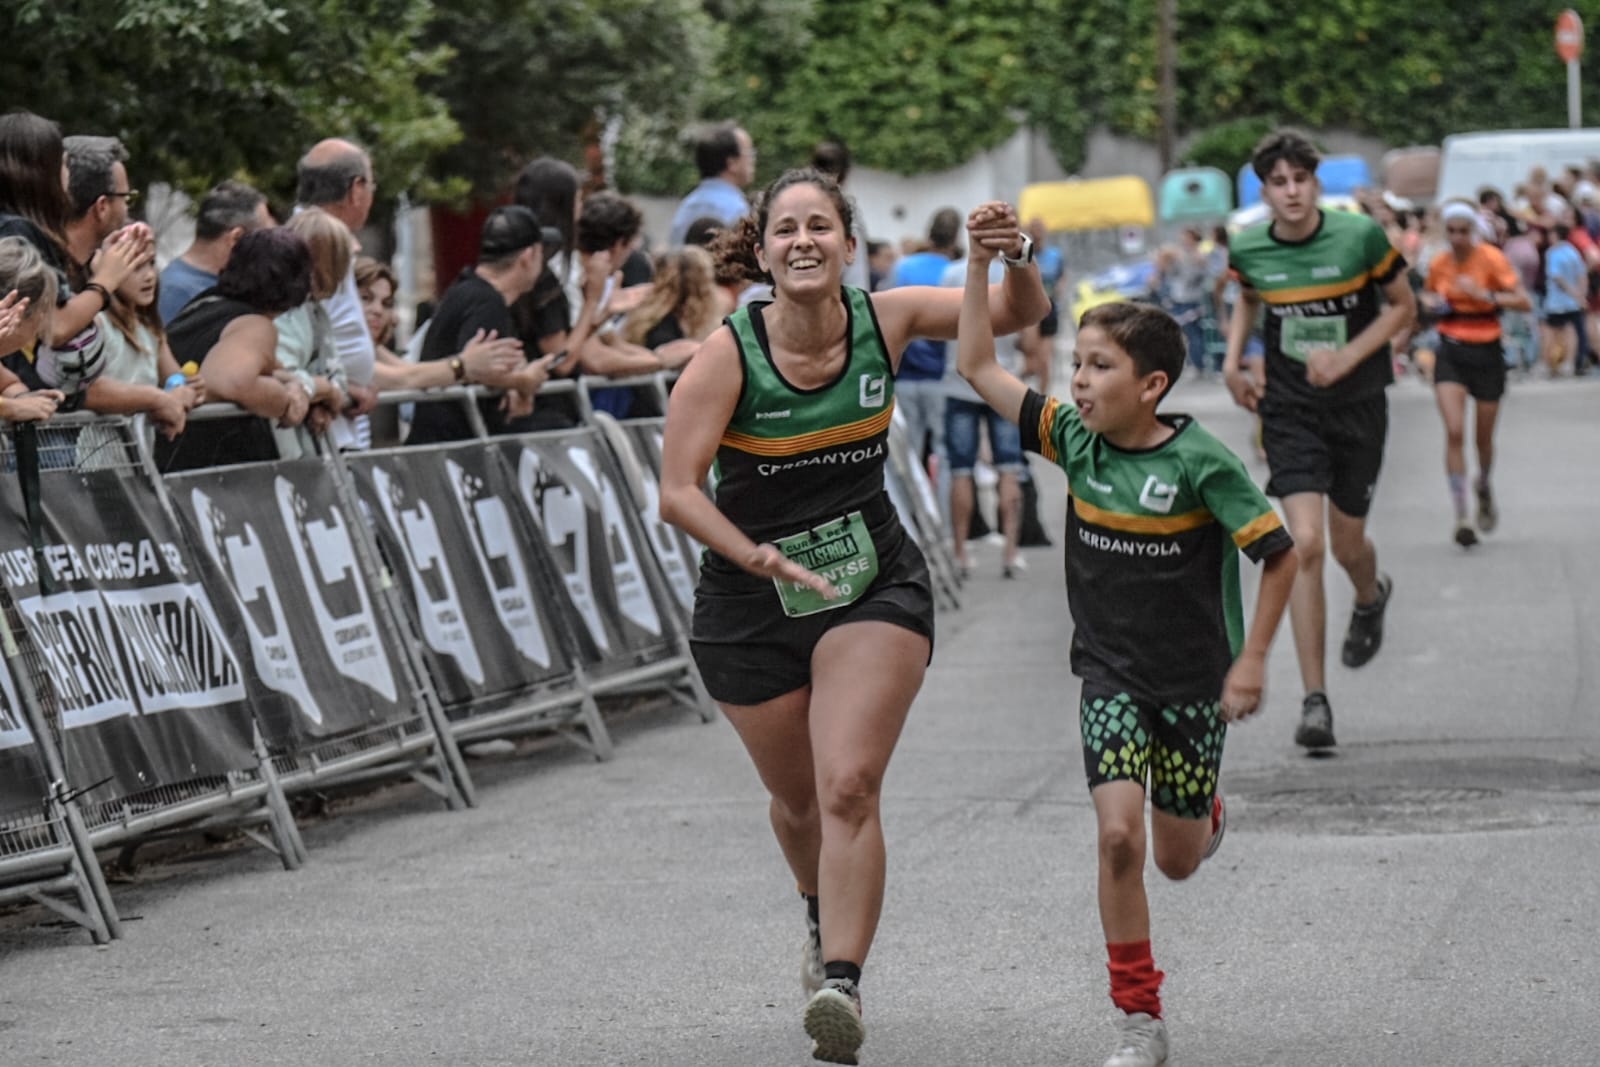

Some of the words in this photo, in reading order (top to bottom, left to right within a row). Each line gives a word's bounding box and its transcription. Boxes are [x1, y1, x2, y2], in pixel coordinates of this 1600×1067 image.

[757, 442, 883, 476] CERDANYOLA
[85, 538, 160, 581] CURSA
[1078, 527, 1181, 557] CERDANYOLA
[793, 557, 870, 593] MNTSE
